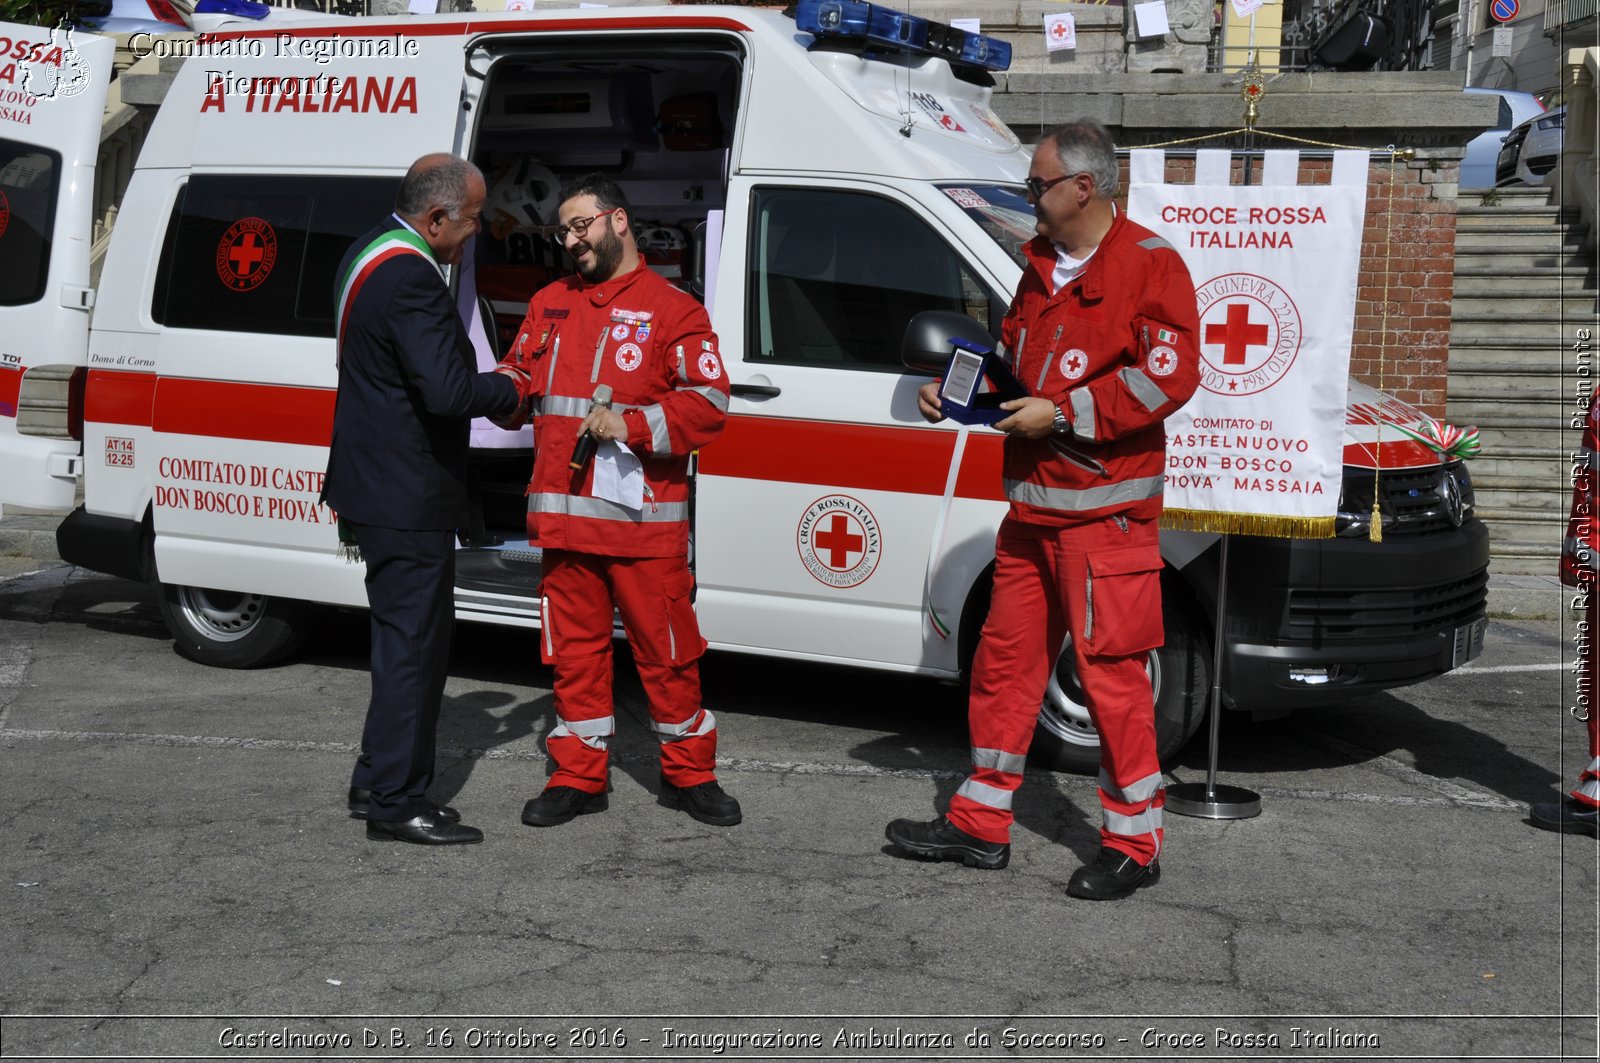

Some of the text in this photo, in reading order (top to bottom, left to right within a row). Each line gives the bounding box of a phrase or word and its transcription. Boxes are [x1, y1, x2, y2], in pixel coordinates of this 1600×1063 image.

[0, 36, 62, 67] OSSA
[0, 63, 16, 84] A
[245, 76, 418, 114] ITALIANA
[1162, 206, 1327, 224] CROCE ROSSA
[1190, 231, 1293, 249] ITALIANA
[1196, 287, 1214, 306] DI
[1214, 277, 1276, 304] GINEVRA
[1273, 302, 1292, 319] 22
[1268, 321, 1296, 373] AGOSTO
[3, 353, 22, 364] TDI
[91, 353, 155, 367] Dono di Corno
[1242, 369, 1271, 391] 1864
[1193, 418, 1272, 431] COMITATO DI
[107, 440, 133, 451] AT 14
[106, 453, 133, 465] 12-25
[1169, 456, 1292, 473] DON BOSCO
[159, 456, 327, 494] COMITATO DI CASTE
[1234, 477, 1324, 495] MASSAIA
[155, 485, 189, 509] DON
[194, 490, 249, 516] BOSCO
[253, 496, 263, 517] E
[800, 499, 878, 554] CROCE ROSSA ITALIANA
[806, 548, 828, 575] COMITATO
[827, 570, 835, 578] DI
